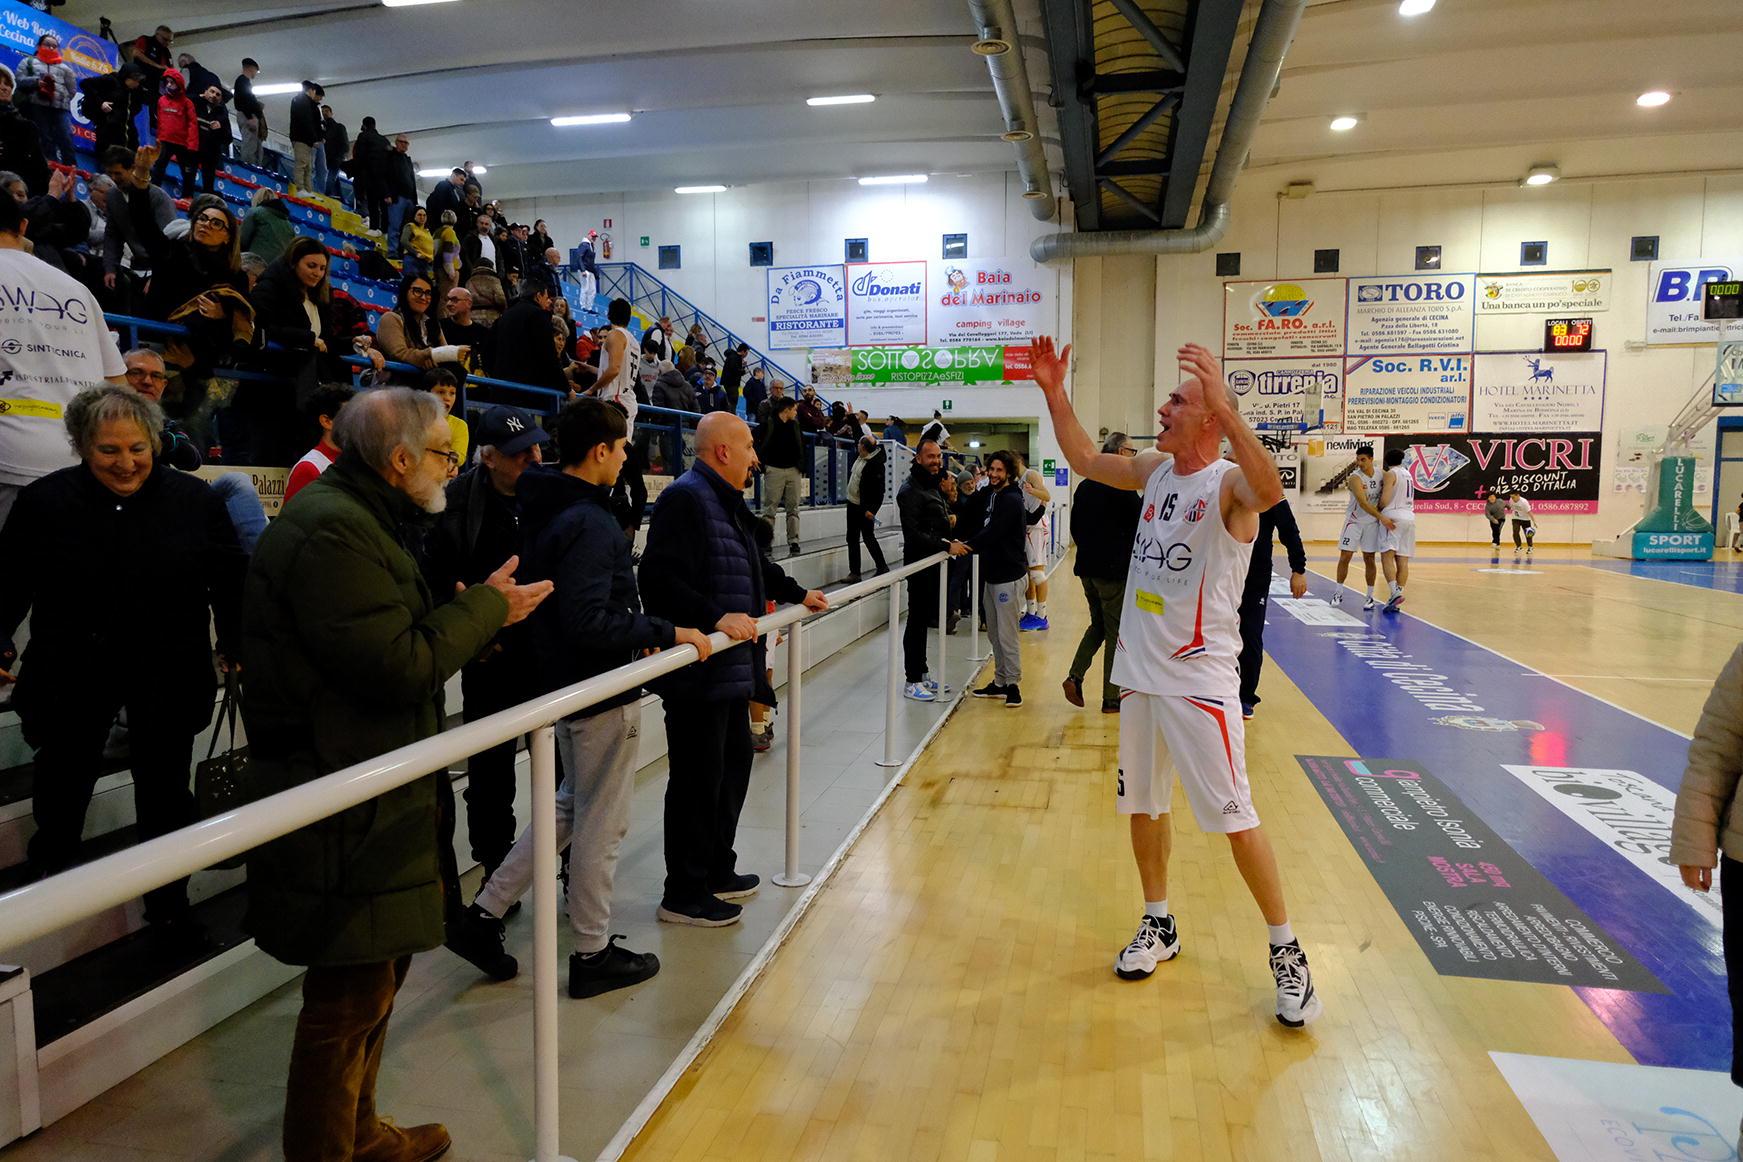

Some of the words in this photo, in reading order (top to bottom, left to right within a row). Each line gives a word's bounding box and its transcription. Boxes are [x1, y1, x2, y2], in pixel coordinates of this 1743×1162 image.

[3, 10, 30, 30] Web
[0, 24, 36, 46] Cecina
[771, 287, 783, 304] Da
[782, 270, 844, 302] Fiammetta
[977, 272, 1011, 284] Baia
[869, 282, 921, 296] Donati
[941, 293, 966, 306] del
[971, 290, 1041, 304] Marinaio
[1385, 281, 1465, 301] TORO
[1482, 302, 1500, 310] Una
[1502, 300, 1531, 309] banca
[776, 320, 840, 330] RISTORANTE
[956, 320, 992, 328] camping
[998, 319, 1026, 328] village
[1258, 318, 1308, 330] FA.RO.
[1312, 320, 1335, 329] a.r.l.
[1553, 325, 1568, 336] 83
[1577, 325, 1589, 335] 72
[857, 350, 920, 370] SOTTO
[1372, 359, 1412, 373] Soc.
[1420, 358, 1467, 372] R.V.I.
[1258, 370, 1338, 395] tirrenia
[1397, 387, 1418, 395] VEICOLI
[1480, 386, 1518, 396] HOTEL
[1522, 385, 1595, 395] MARINETTA
[506, 416, 524, 432] NY
[1467, 439, 1594, 471] VICRI
[252, 474, 284, 495] Palazzi
[1497, 476, 1507, 485] IL
[1512, 471, 1568, 485] DISCOUNT
[1533, 480, 1577, 491] D'ITALIA
[1674, 458, 1684, 531] LUCARELLI
[1159, 493, 1178, 521] 15
[1435, 502, 1453, 511] Sud,
[1538, 503, 1589, 511] 0586.687892
[1650, 535, 1702, 546] SPORT
[1337, 640, 1412, 658] Città
[1365, 660, 1432, 670] di
[1382, 672, 1484, 712] Cecina
[1355, 776, 1419, 831] commerciale
[1434, 819, 1483, 849] Isonia
[1426, 856, 1467, 888] MOSTRA
[1455, 862, 1488, 884] SALA
[1412, 910, 1436, 934] PISCINE
[1431, 934, 1448, 948] SPA
[1564, 918, 1623, 964] COMMERCIO
